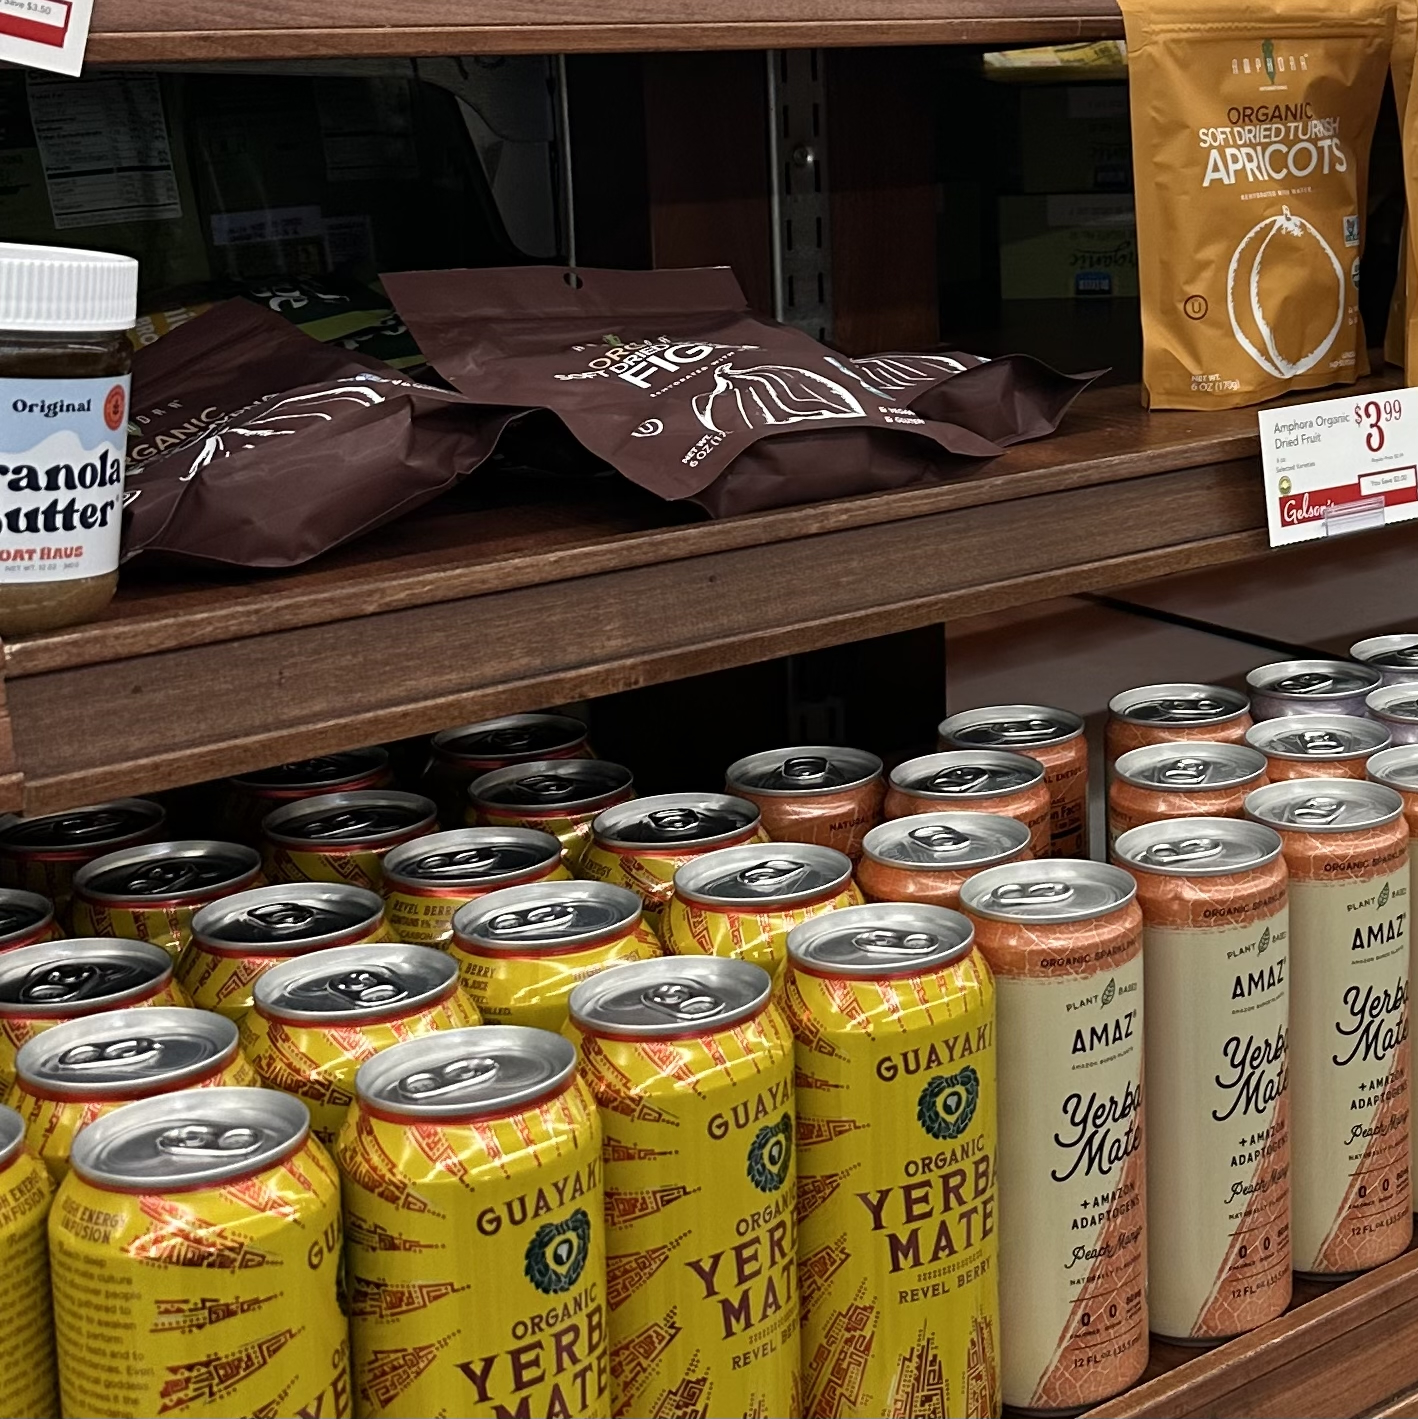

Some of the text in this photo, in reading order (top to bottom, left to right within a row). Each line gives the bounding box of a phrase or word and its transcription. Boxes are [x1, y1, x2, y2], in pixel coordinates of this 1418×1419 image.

[1199, 117, 1340, 148] SOFT DRIED TURKISH
[1227, 102, 1314, 125] ORGANIC
[1202, 138, 1347, 187] APRICOTS
[12, 398, 92, 418] Original
[1274, 412, 1350, 435] Amphora Organic
[1275, 432, 1322, 450] Dried Fruit
[0, 498, 114, 533] utter
[40, 545, 83, 561] HAUS
[1351, 915, 1405, 951] AMAZ
[1231, 958, 1286, 1000] AMAZ
[1071, 1009, 1135, 1054] AMAZ
[876, 1024, 994, 1082] GUAYAKI
[1054, 1080, 1141, 1148] Yerba
[904, 1133, 985, 1179] ORGANIC
[1050, 1124, 1141, 1183] Mate
[1071, 1198, 1141, 1232] ADAPTOGENS
[885, 1201, 994, 1275] MATE
[899, 1254, 993, 1305] REVEL BERRY
[511, 1283, 598, 1342] ORGANIC
